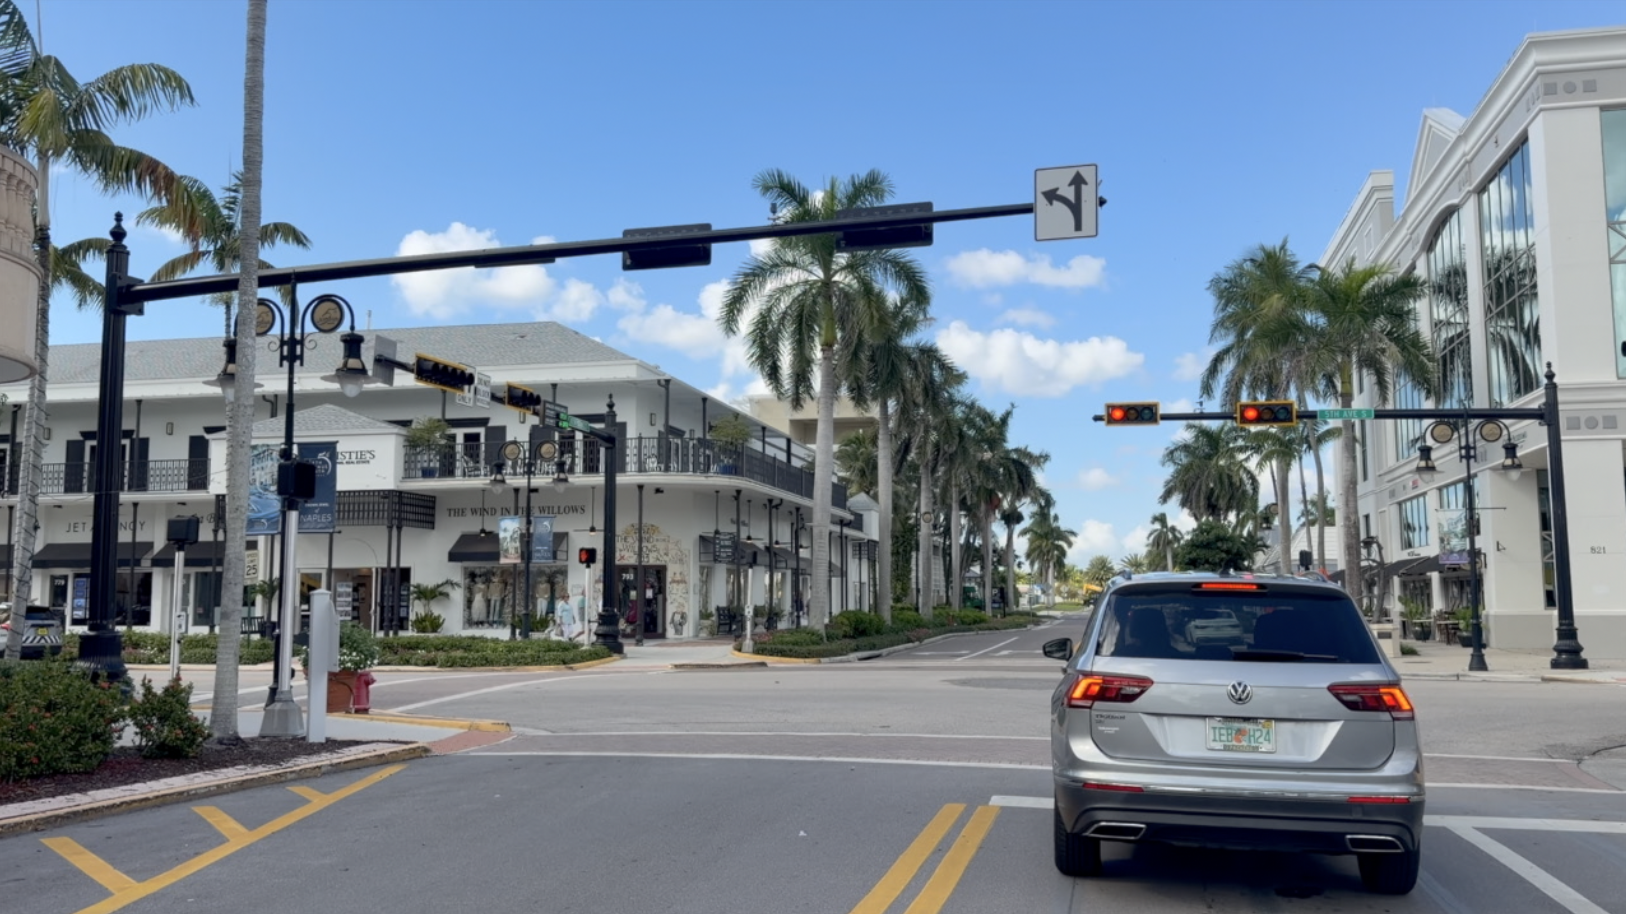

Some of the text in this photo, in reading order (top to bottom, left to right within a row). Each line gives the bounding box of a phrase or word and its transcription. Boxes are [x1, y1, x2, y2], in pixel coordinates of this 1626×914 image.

[1325, 410, 1367, 418] 5TH AVE S
[336, 450, 376, 460] ISTIE'S
[447, 507, 467, 517] THE
[470, 507, 497, 517] WIND
[500, 506, 511, 516] IN
[538, 505, 586, 515] WILLOWS
[300, 513, 332, 522] NAPLES
[65, 522, 87, 533] JET
[1590, 545, 1606, 554] 821
[246, 564, 258, 576] 25
[1248, 728, 1271, 745] H24
